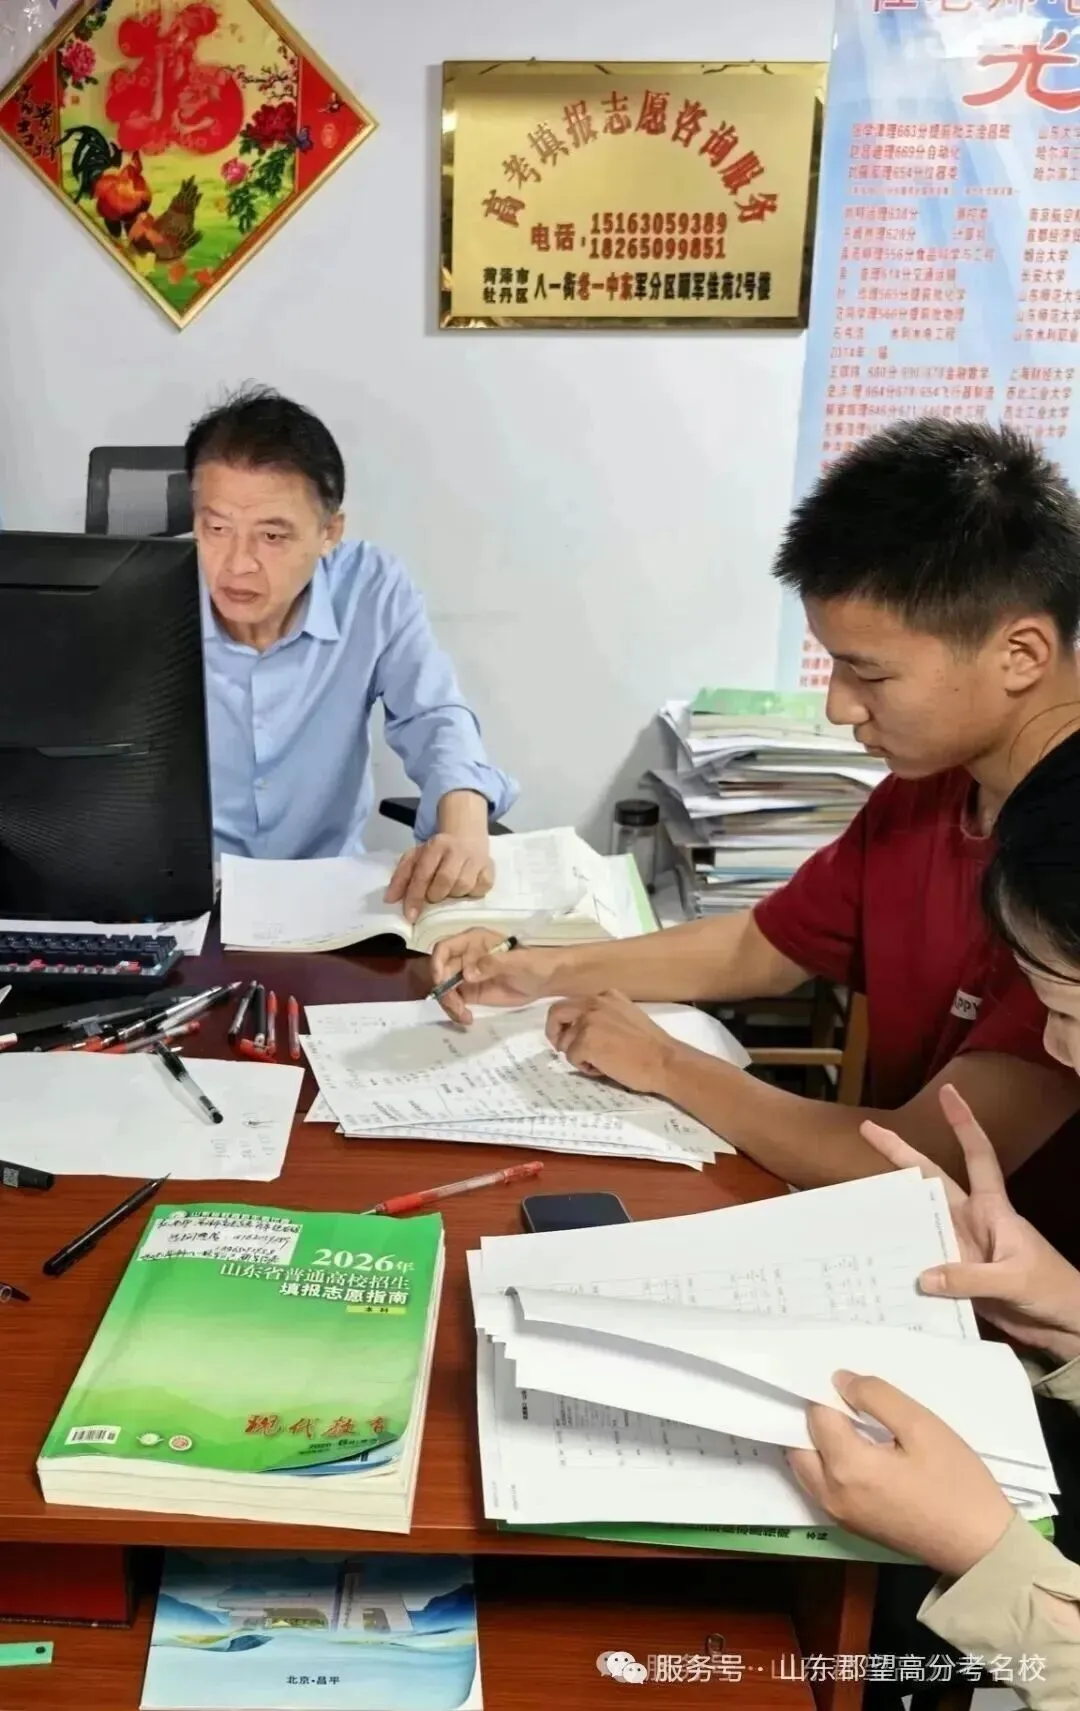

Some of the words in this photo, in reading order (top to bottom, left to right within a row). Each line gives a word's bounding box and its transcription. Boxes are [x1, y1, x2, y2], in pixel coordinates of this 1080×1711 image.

[480, 88, 779, 228] 高考填报志愿咨询服务
[590, 211, 728, 235] 15163059389
[588, 237, 727, 260] 18265099851
[483, 267, 530, 284] 菏泽市
[483, 287, 528, 304] 牡丹区
[311, 1248, 415, 1274] 2026年
[220, 1263, 411, 1291] 山东省普通高校招生
[279, 1282, 409, 1306] 填报志愿指南
